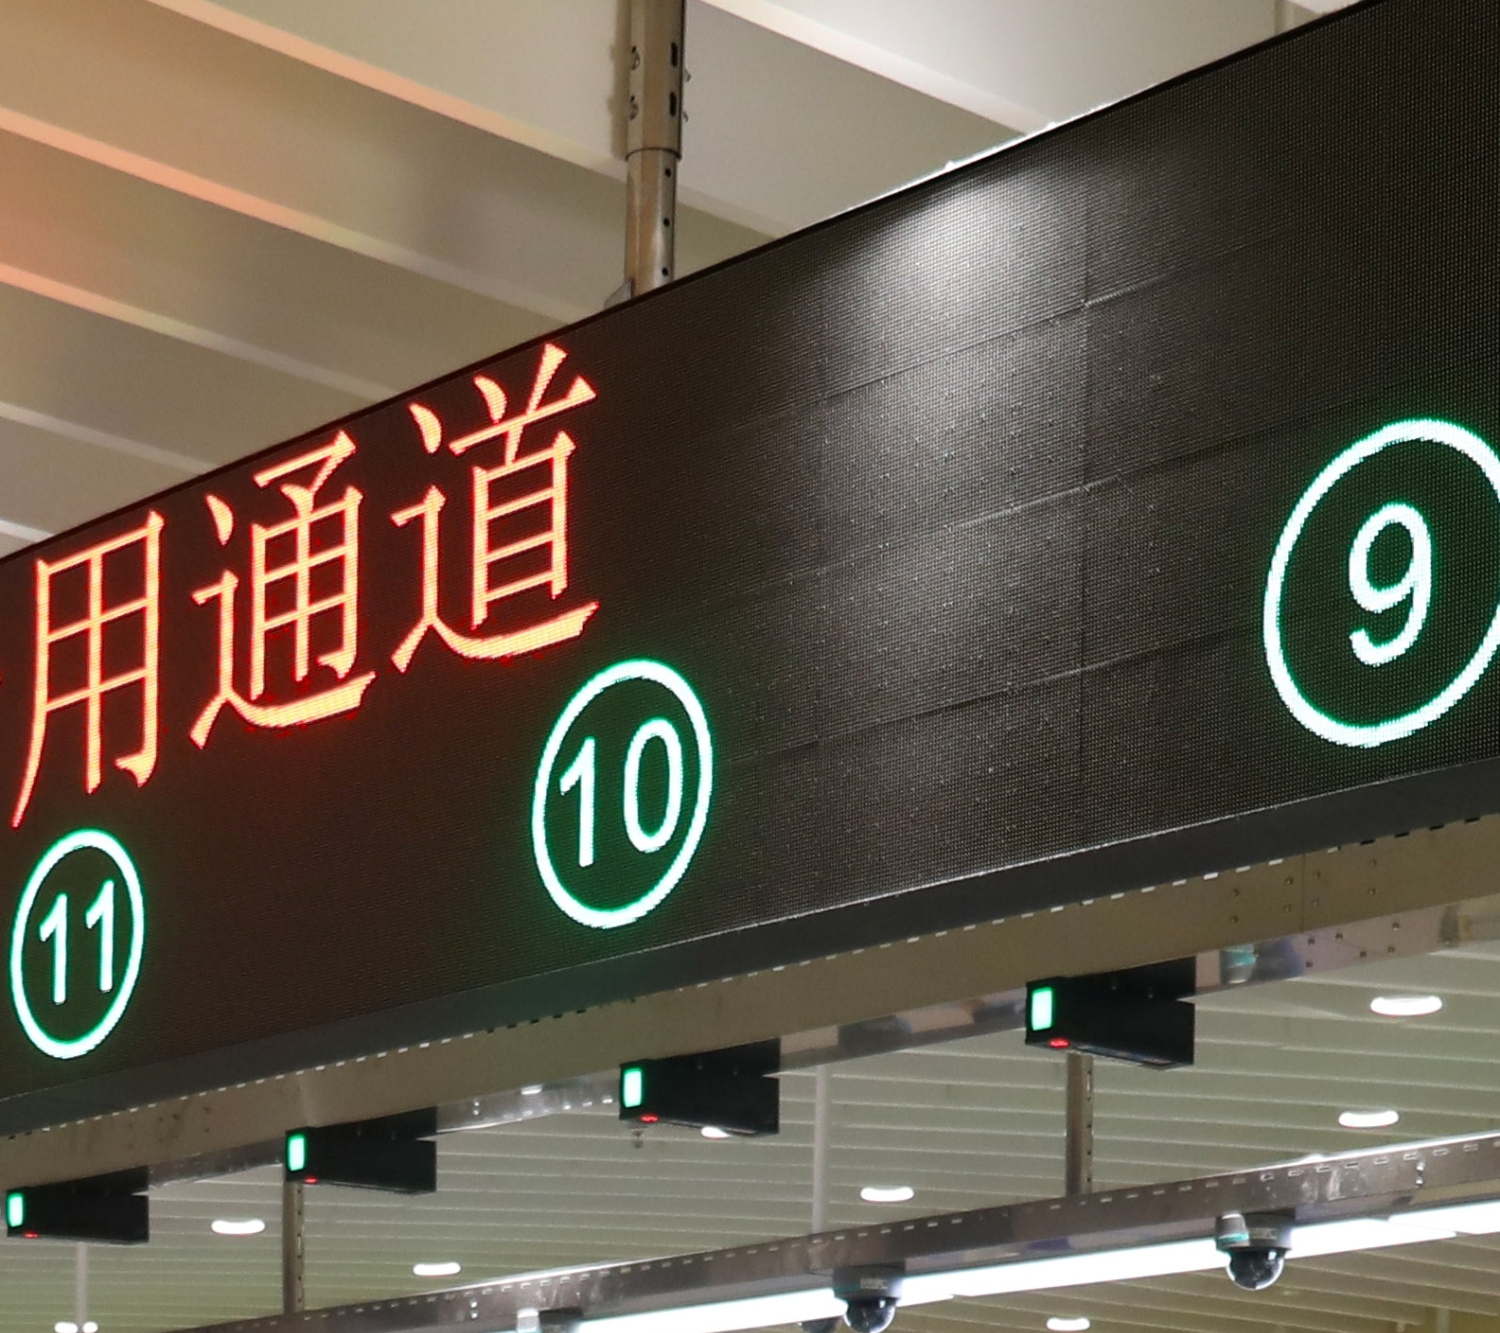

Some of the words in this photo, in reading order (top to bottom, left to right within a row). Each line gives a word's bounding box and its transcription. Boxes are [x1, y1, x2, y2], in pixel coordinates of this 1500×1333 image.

[1349, 502, 1431, 667] 9
[560, 718, 683, 866] 10
[40, 880, 114, 1003] 11
